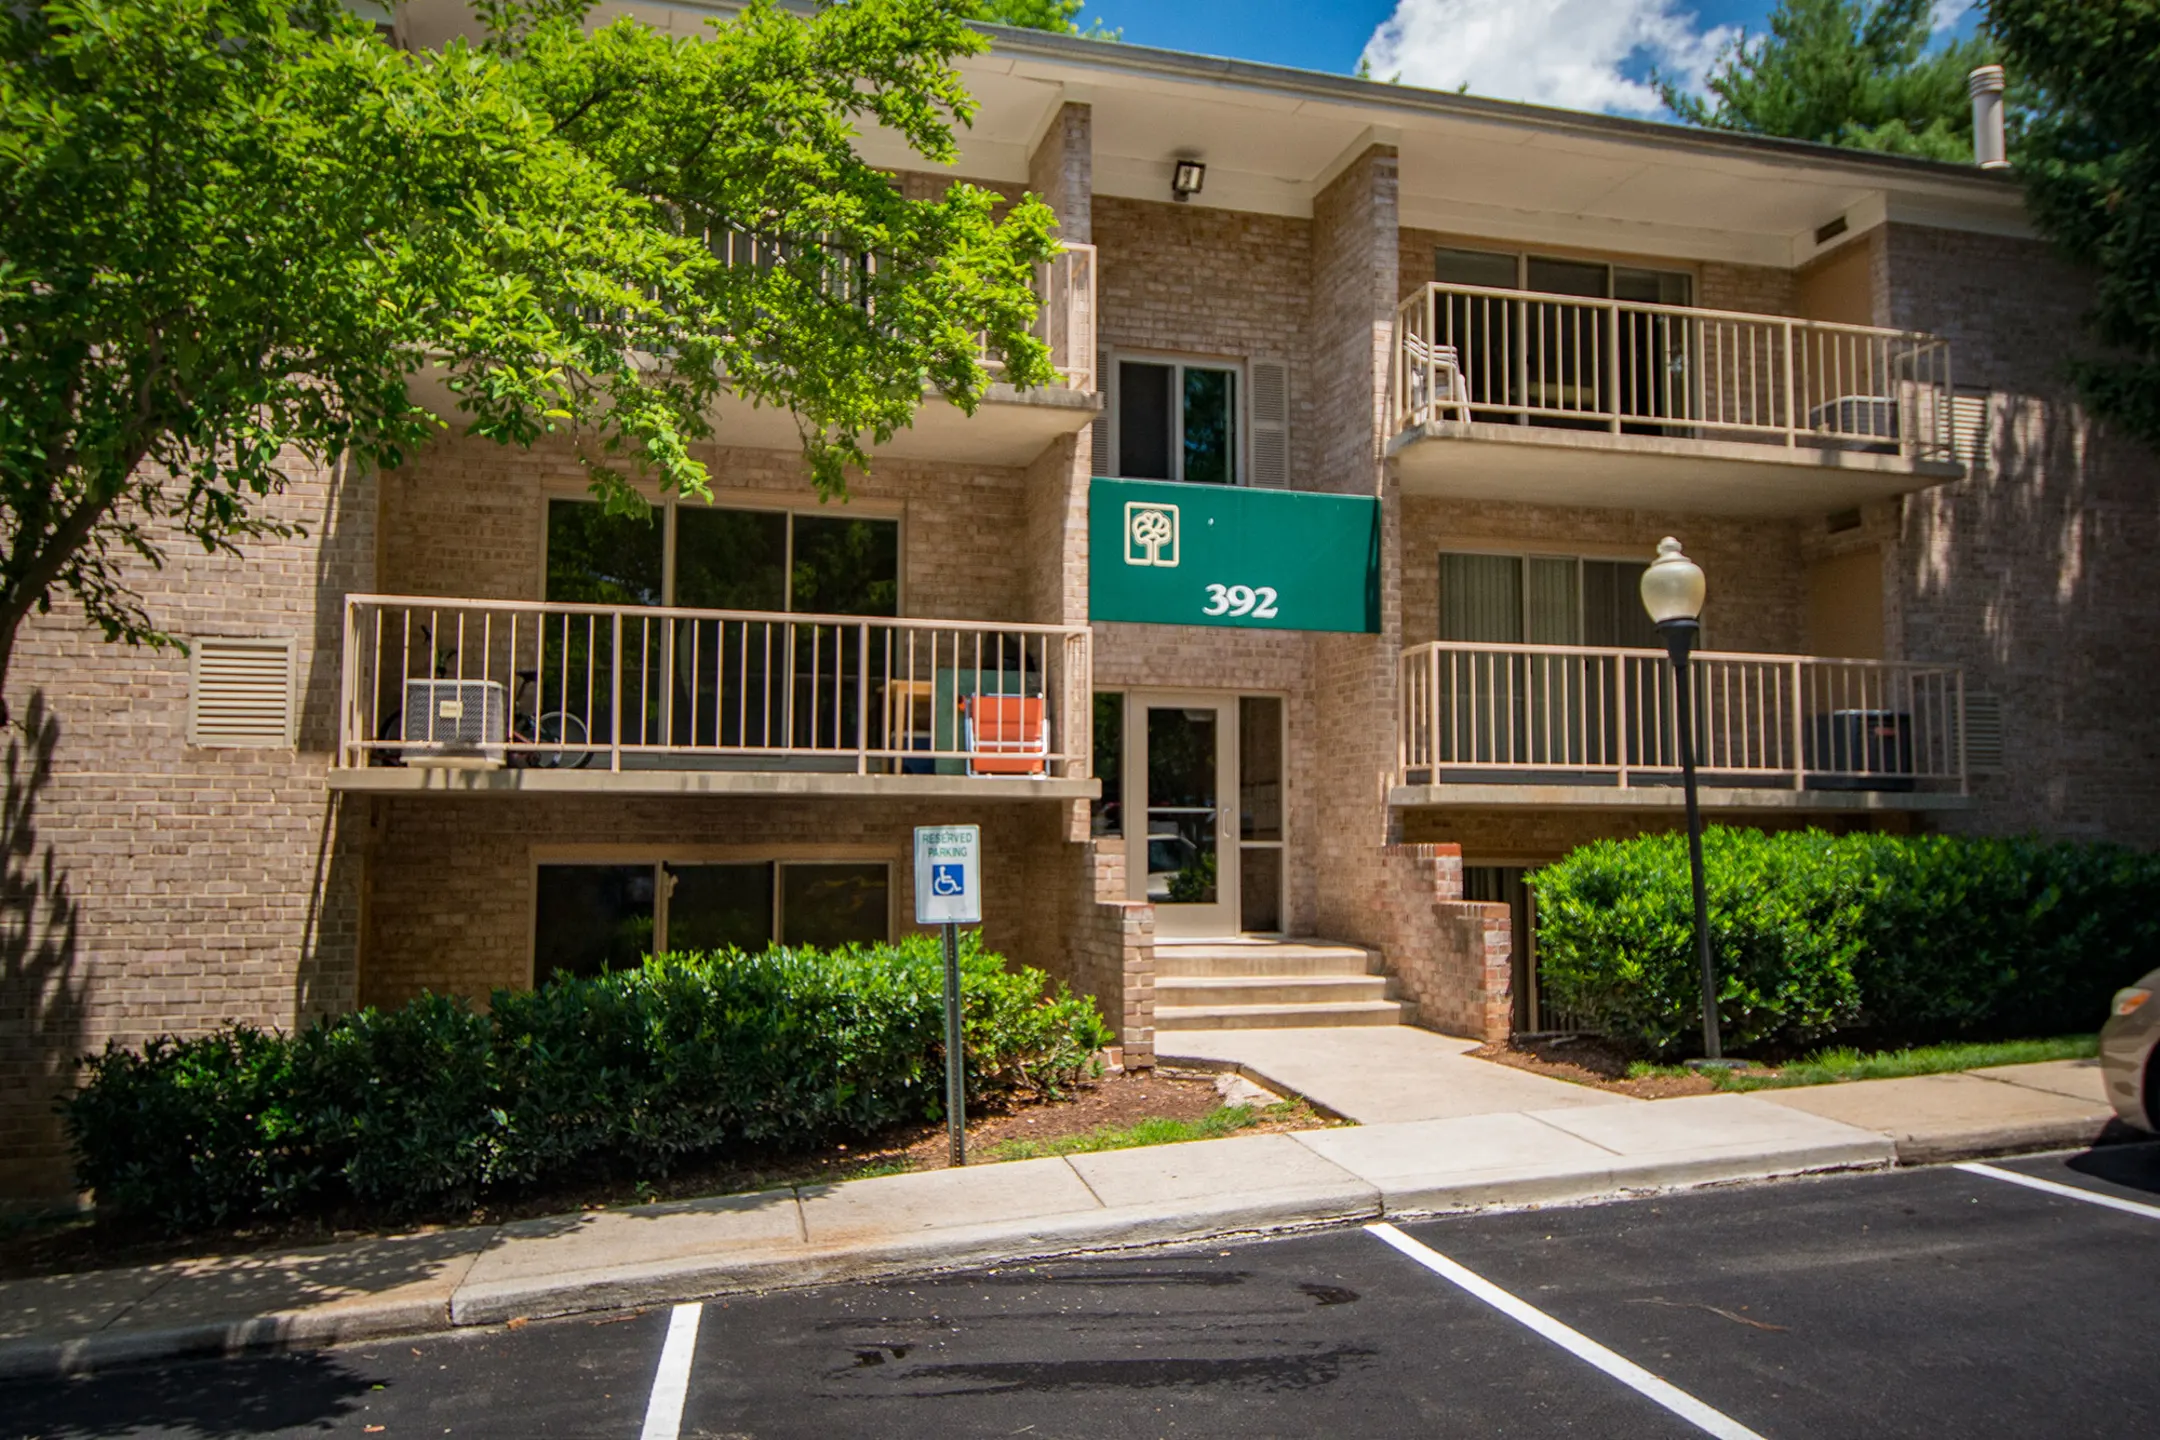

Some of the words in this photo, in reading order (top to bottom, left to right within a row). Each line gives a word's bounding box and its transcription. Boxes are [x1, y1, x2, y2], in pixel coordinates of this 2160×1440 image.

[1202, 583, 1279, 618] 392
[922, 832, 973, 844] RESERVED
[927, 846, 968, 858] PARKING
